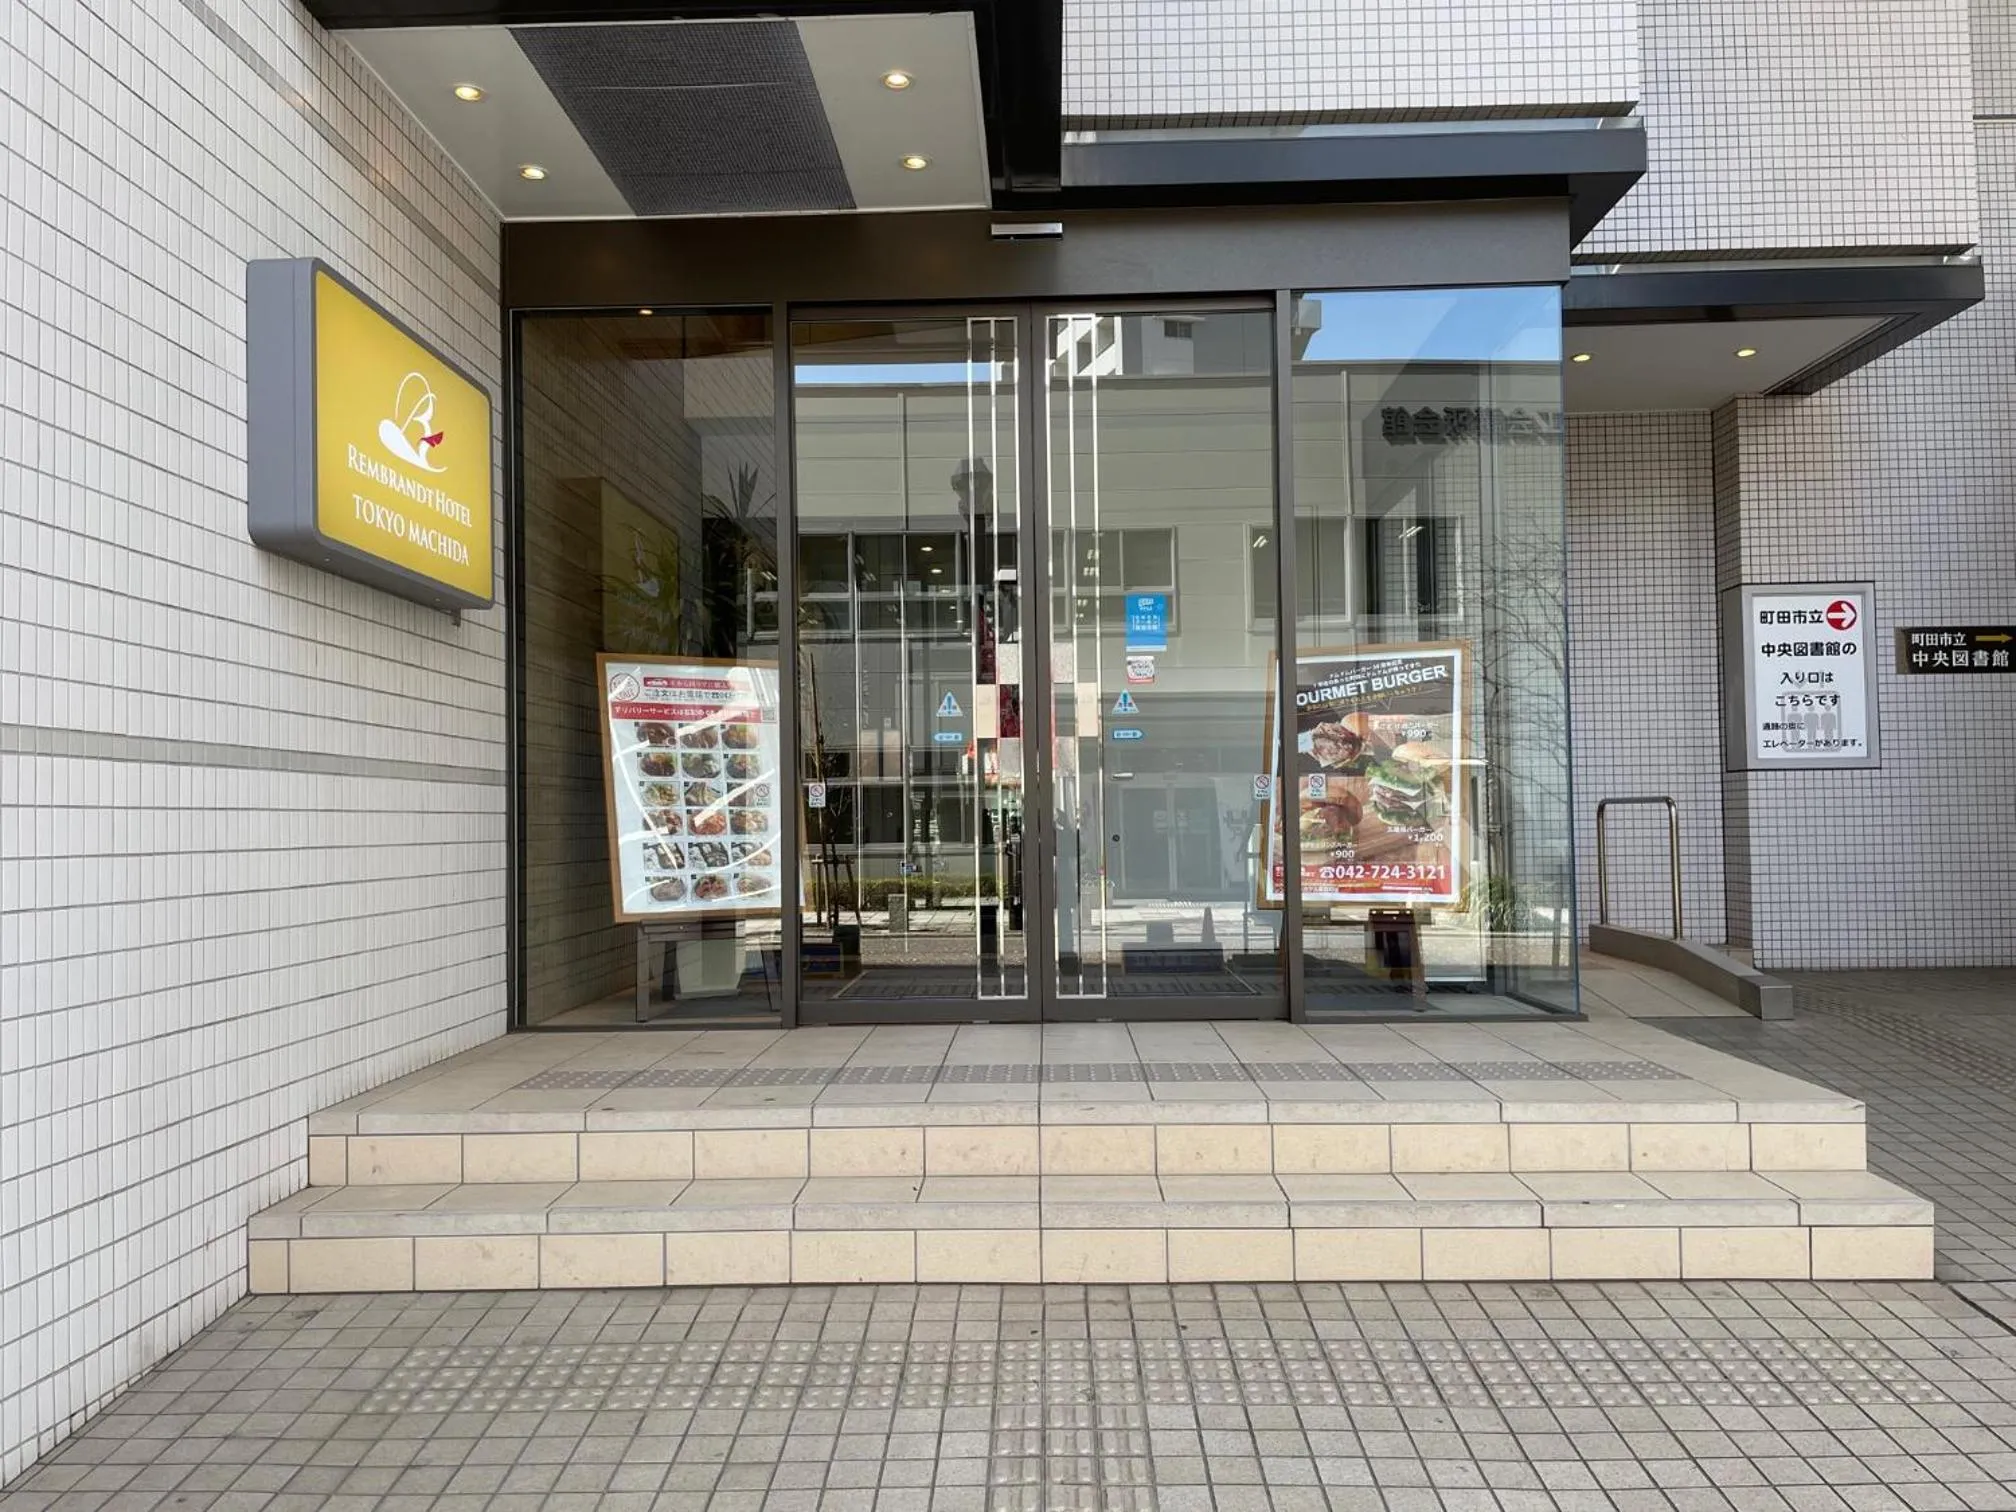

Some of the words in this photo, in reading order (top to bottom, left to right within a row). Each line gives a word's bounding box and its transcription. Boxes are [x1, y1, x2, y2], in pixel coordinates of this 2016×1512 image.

[348, 443, 434, 508] REMBRANDT
[435, 489, 472, 528] HOTEL
[352, 494, 405, 537] TOKYO
[409, 520, 469, 566] MACHIDA
[1760, 610, 1824, 625] 町田市立
[1911, 633, 1967, 646] 町田市立
[1761, 641, 1857, 657] 中央図書館の
[1912, 650, 2009, 667] 中央図書館
[1297, 681, 1370, 706] OURMET
[1372, 665, 1449, 693] BURGER
[1780, 672, 1833, 684] 入り口は
[1775, 695, 1840, 706] こちらです
[1763, 738, 1863, 749] エレベーターがあります。
[1335, 865, 1446, 880] 042-724-3121
